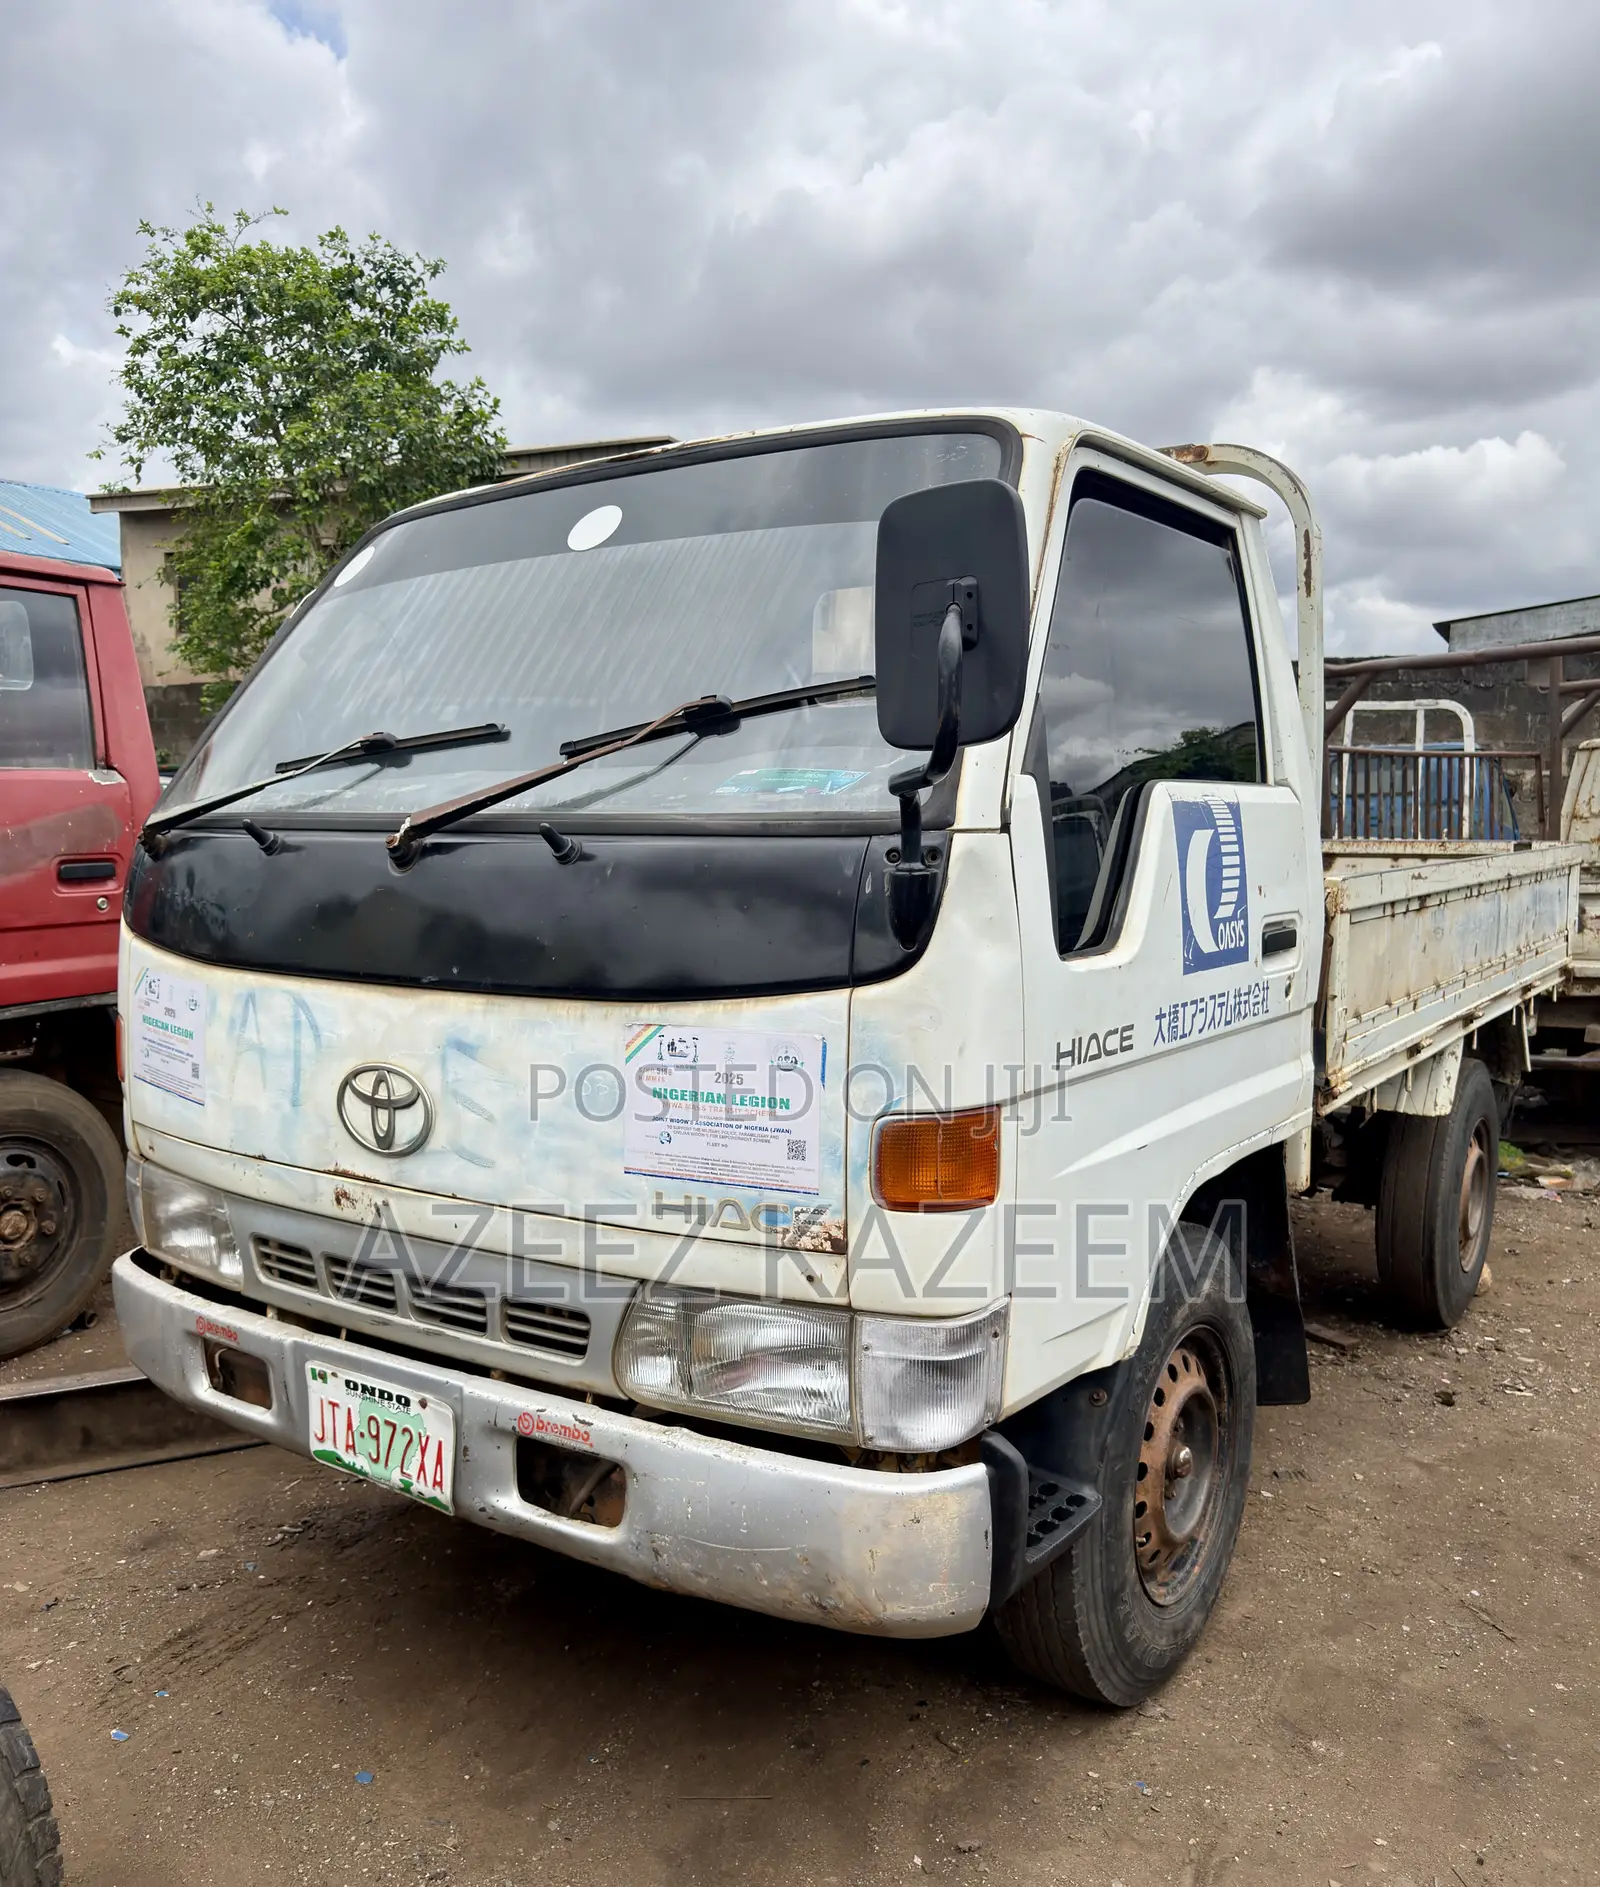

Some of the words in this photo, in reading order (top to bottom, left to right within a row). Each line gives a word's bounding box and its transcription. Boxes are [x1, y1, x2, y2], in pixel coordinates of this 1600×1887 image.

[1218, 919, 1246, 951] OASYS
[1153, 980, 1271, 1048] 大橋エアシステム株式会社
[1056, 1023, 1135, 1071] HIACE
[714, 1071, 744, 1086] 2025
[652, 1087, 727, 1105] NIGERIAN
[731, 1093, 791, 1110] LEGION
[694, 1119, 734, 1129] ASSOCIATION
[744, 1124, 769, 1133] NIGERIA
[770, 1126, 792, 1135] (JWAN)
[344, 1379, 411, 1408] ONDO
[345, 1388, 386, 1409] SUNSHINE
[387, 1400, 412, 1415] STATE
[536, 1414, 591, 1443] brembo
